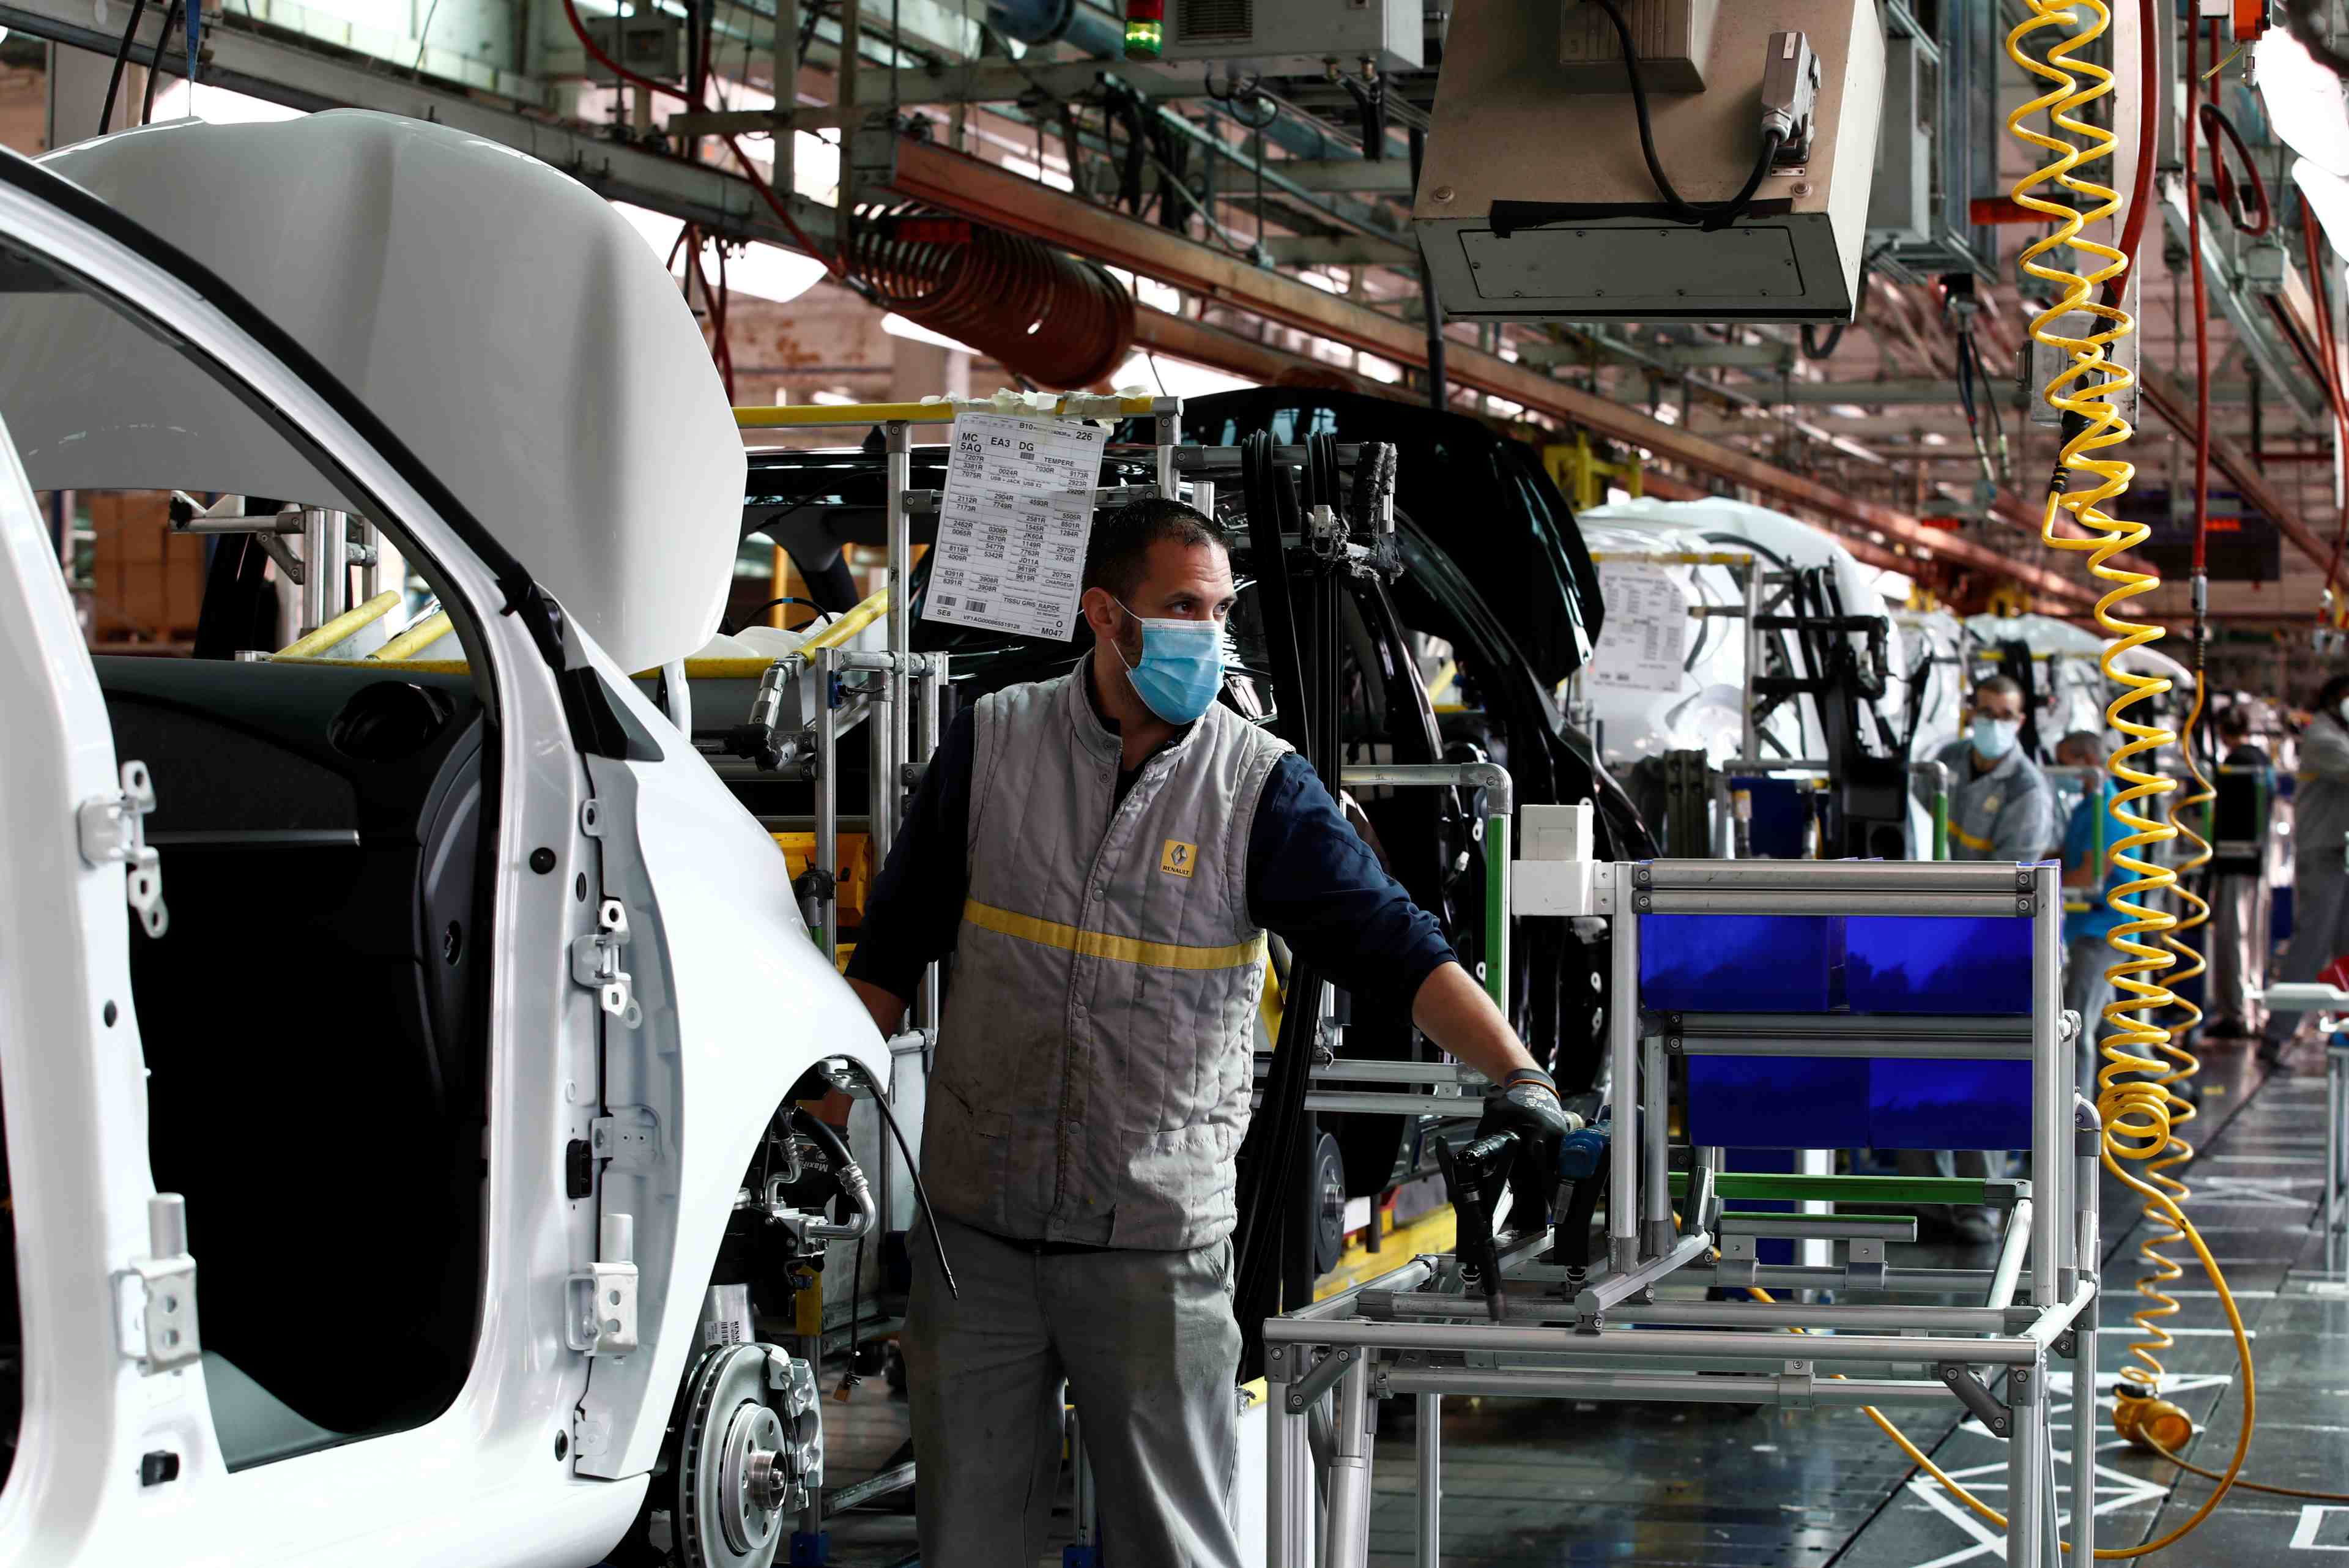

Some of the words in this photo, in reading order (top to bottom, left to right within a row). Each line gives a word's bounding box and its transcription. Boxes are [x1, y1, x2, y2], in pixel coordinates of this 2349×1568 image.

[962, 433, 978, 442] MC
[1076, 431, 1093, 441] 226
[991, 437, 1010, 447] EA3
[1019, 442, 1034, 451] DG
[960, 442, 981, 452] 5AQ
[1044, 457, 1075, 467] TEMPERE
[962, 470, 982, 479] 7075R
[1036, 466, 1055, 474] 7030R
[958, 496, 977, 504] 2112R
[957, 503, 976, 512] 7173R
[1038, 603, 1060, 612] RAPIDE
[1041, 627, 1063, 637] M047
[1162, 865, 1190, 875] RENAULT
